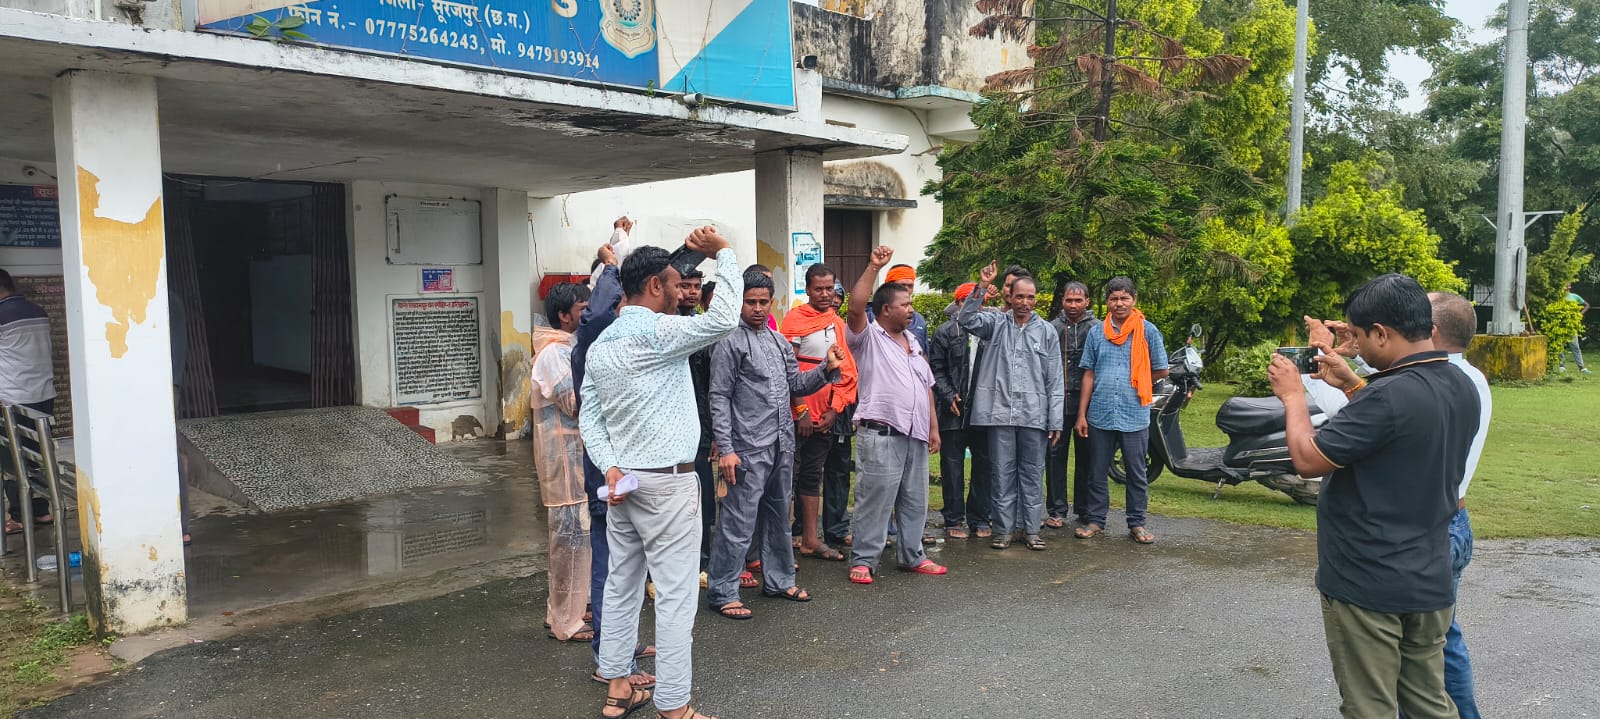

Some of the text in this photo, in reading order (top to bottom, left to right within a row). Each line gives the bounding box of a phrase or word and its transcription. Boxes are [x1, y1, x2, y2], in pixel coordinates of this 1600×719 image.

[432, 0, 481, 27] सूरजपुर
[484, 4, 530, 34] (छ.ग.)
[490, 33, 512, 56] मो.
[517, 42, 600, 69] 9479193914
